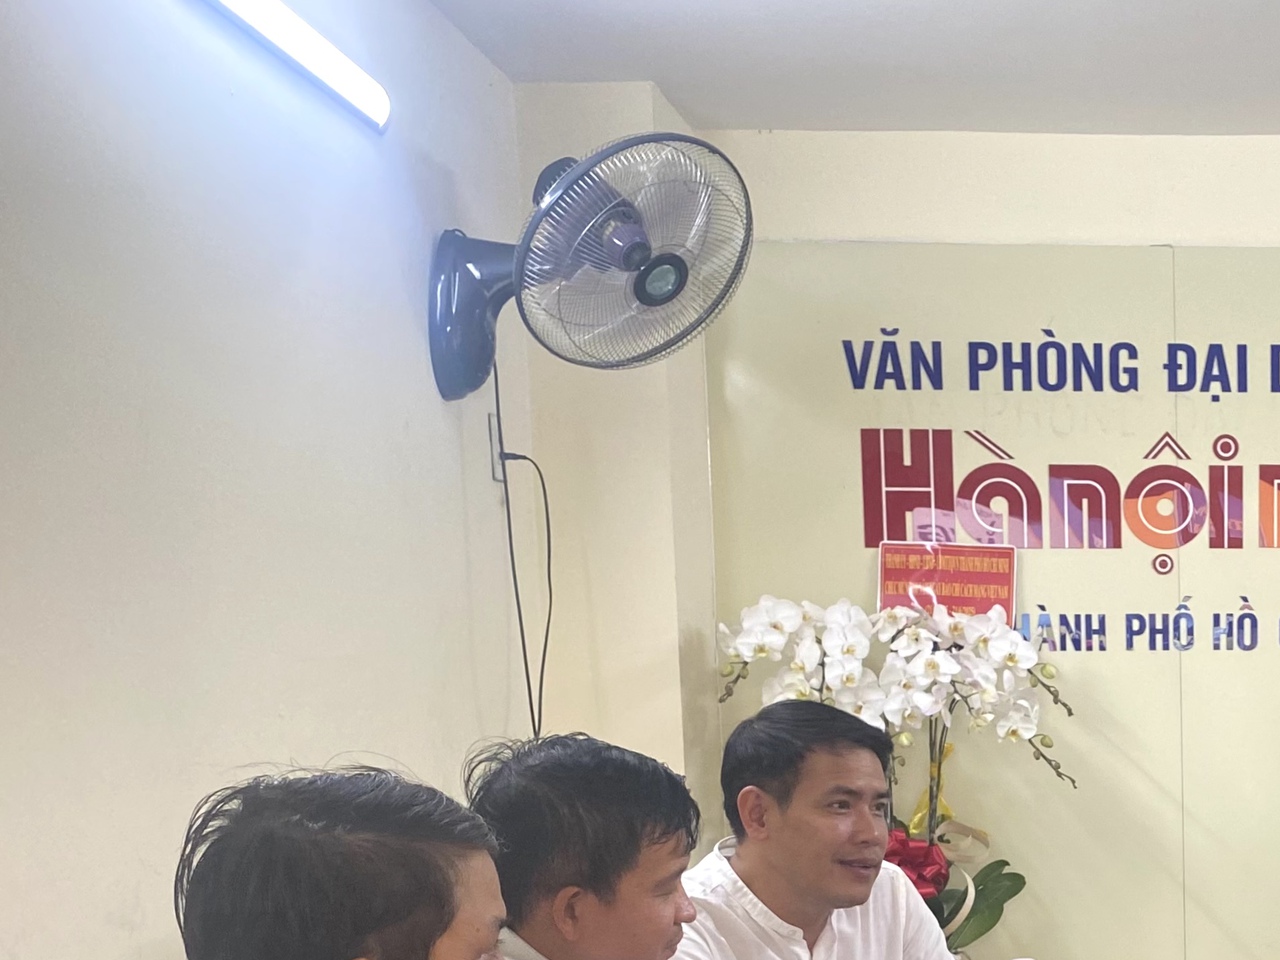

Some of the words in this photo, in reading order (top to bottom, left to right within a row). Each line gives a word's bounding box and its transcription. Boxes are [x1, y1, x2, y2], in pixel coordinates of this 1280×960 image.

[842, 327, 943, 391] VĂN
[968, 329, 1139, 393] PHÒNG
[1163, 343, 1249, 402] ĐẠI
[1125, 595, 1195, 652] PHỐ
[1212, 595, 1259, 652] HỒ
